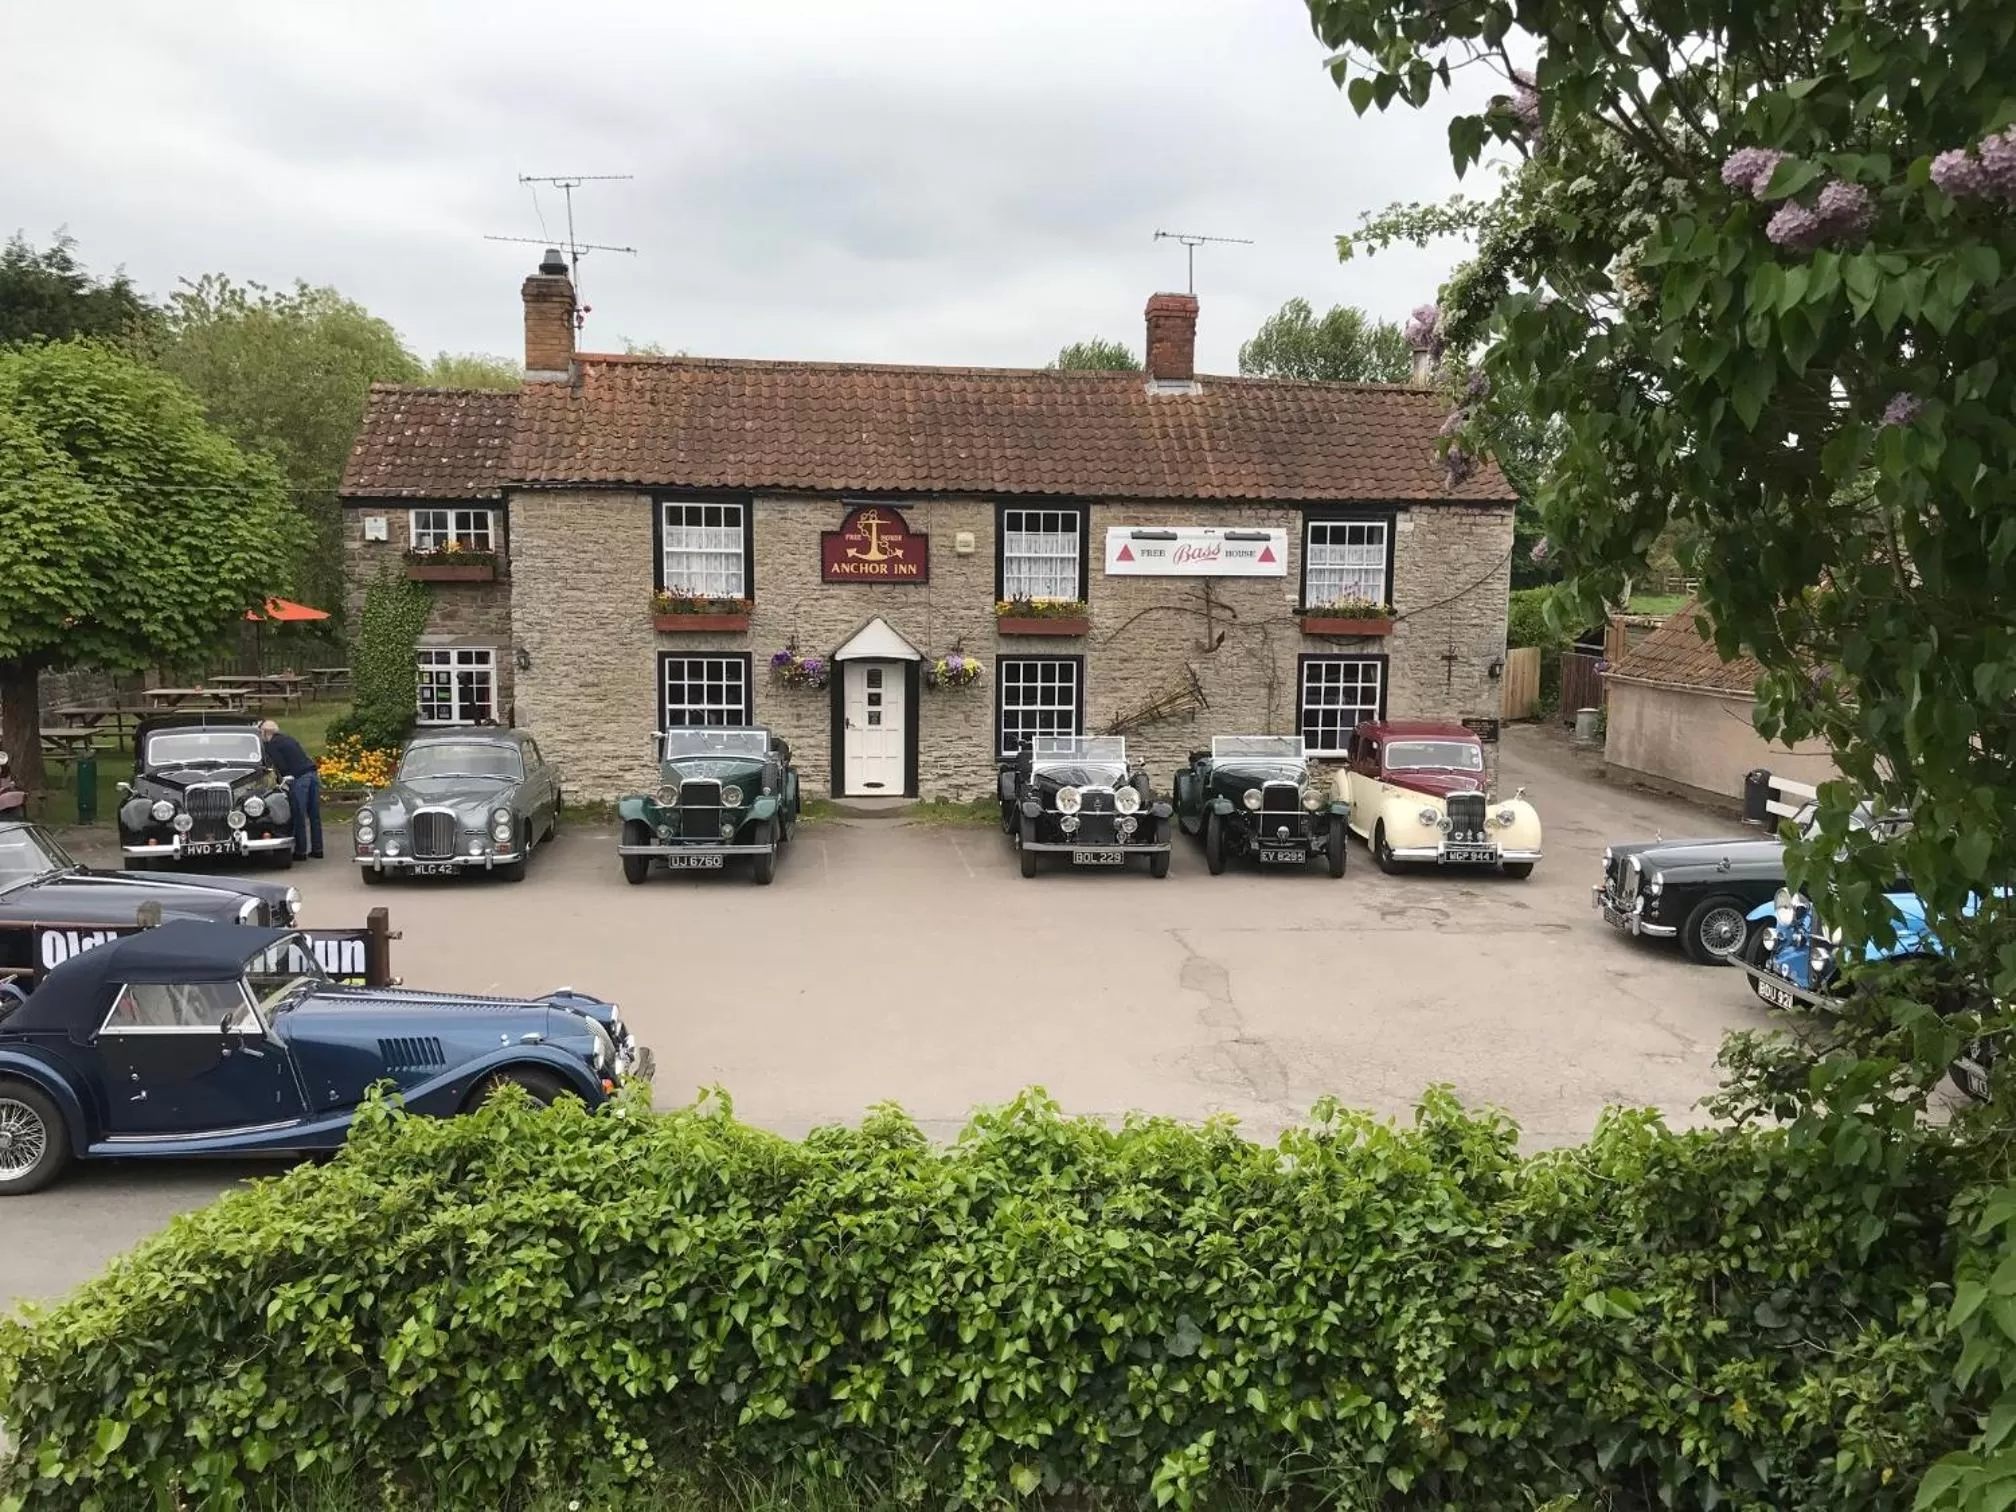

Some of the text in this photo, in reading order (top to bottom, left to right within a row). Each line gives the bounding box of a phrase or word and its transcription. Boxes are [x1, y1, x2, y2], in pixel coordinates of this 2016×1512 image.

[1140, 542, 1256, 565] FREE Bass HOUSE
[831, 562, 917, 575] ANCHOR INN
[187, 844, 211, 855] HVD
[671, 855, 688, 867] UJ
